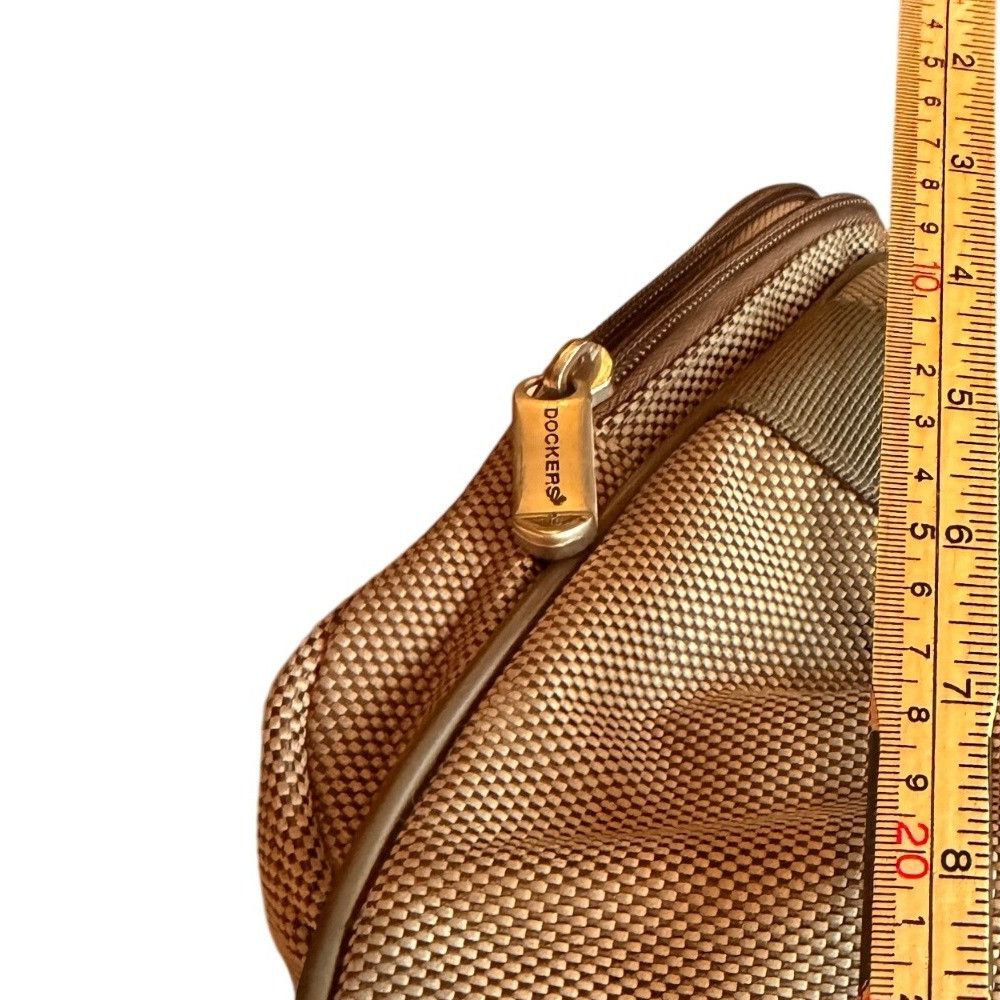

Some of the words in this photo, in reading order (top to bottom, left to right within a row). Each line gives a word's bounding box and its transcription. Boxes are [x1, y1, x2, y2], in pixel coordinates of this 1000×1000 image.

[923, 55, 945, 68] 5
[952, 53, 975, 67] 2
[923, 96, 942, 107] 6
[922, 138, 941, 149] 7
[951, 154, 974, 169] 3
[920, 178, 940, 190] 8
[920, 222, 939, 234] 9
[912, 262, 941, 292] 10
[949, 265, 973, 281] 4
[916, 363, 937, 377] 2
[947, 388, 973, 405] 5
[915, 414, 936, 428] 3
[544, 407, 562, 502] DOCKERS
[914, 468, 934, 482] 4
[909, 522, 936, 540] 5
[945, 524, 973, 544] 6
[910, 582, 932, 597] 6
[909, 644, 931, 659] 7
[943, 678, 971, 699] 7
[907, 706, 930, 722] 8
[905, 774, 929, 791] 9
[895, 820, 930, 880] 20
[940, 848, 972, 872] 8
